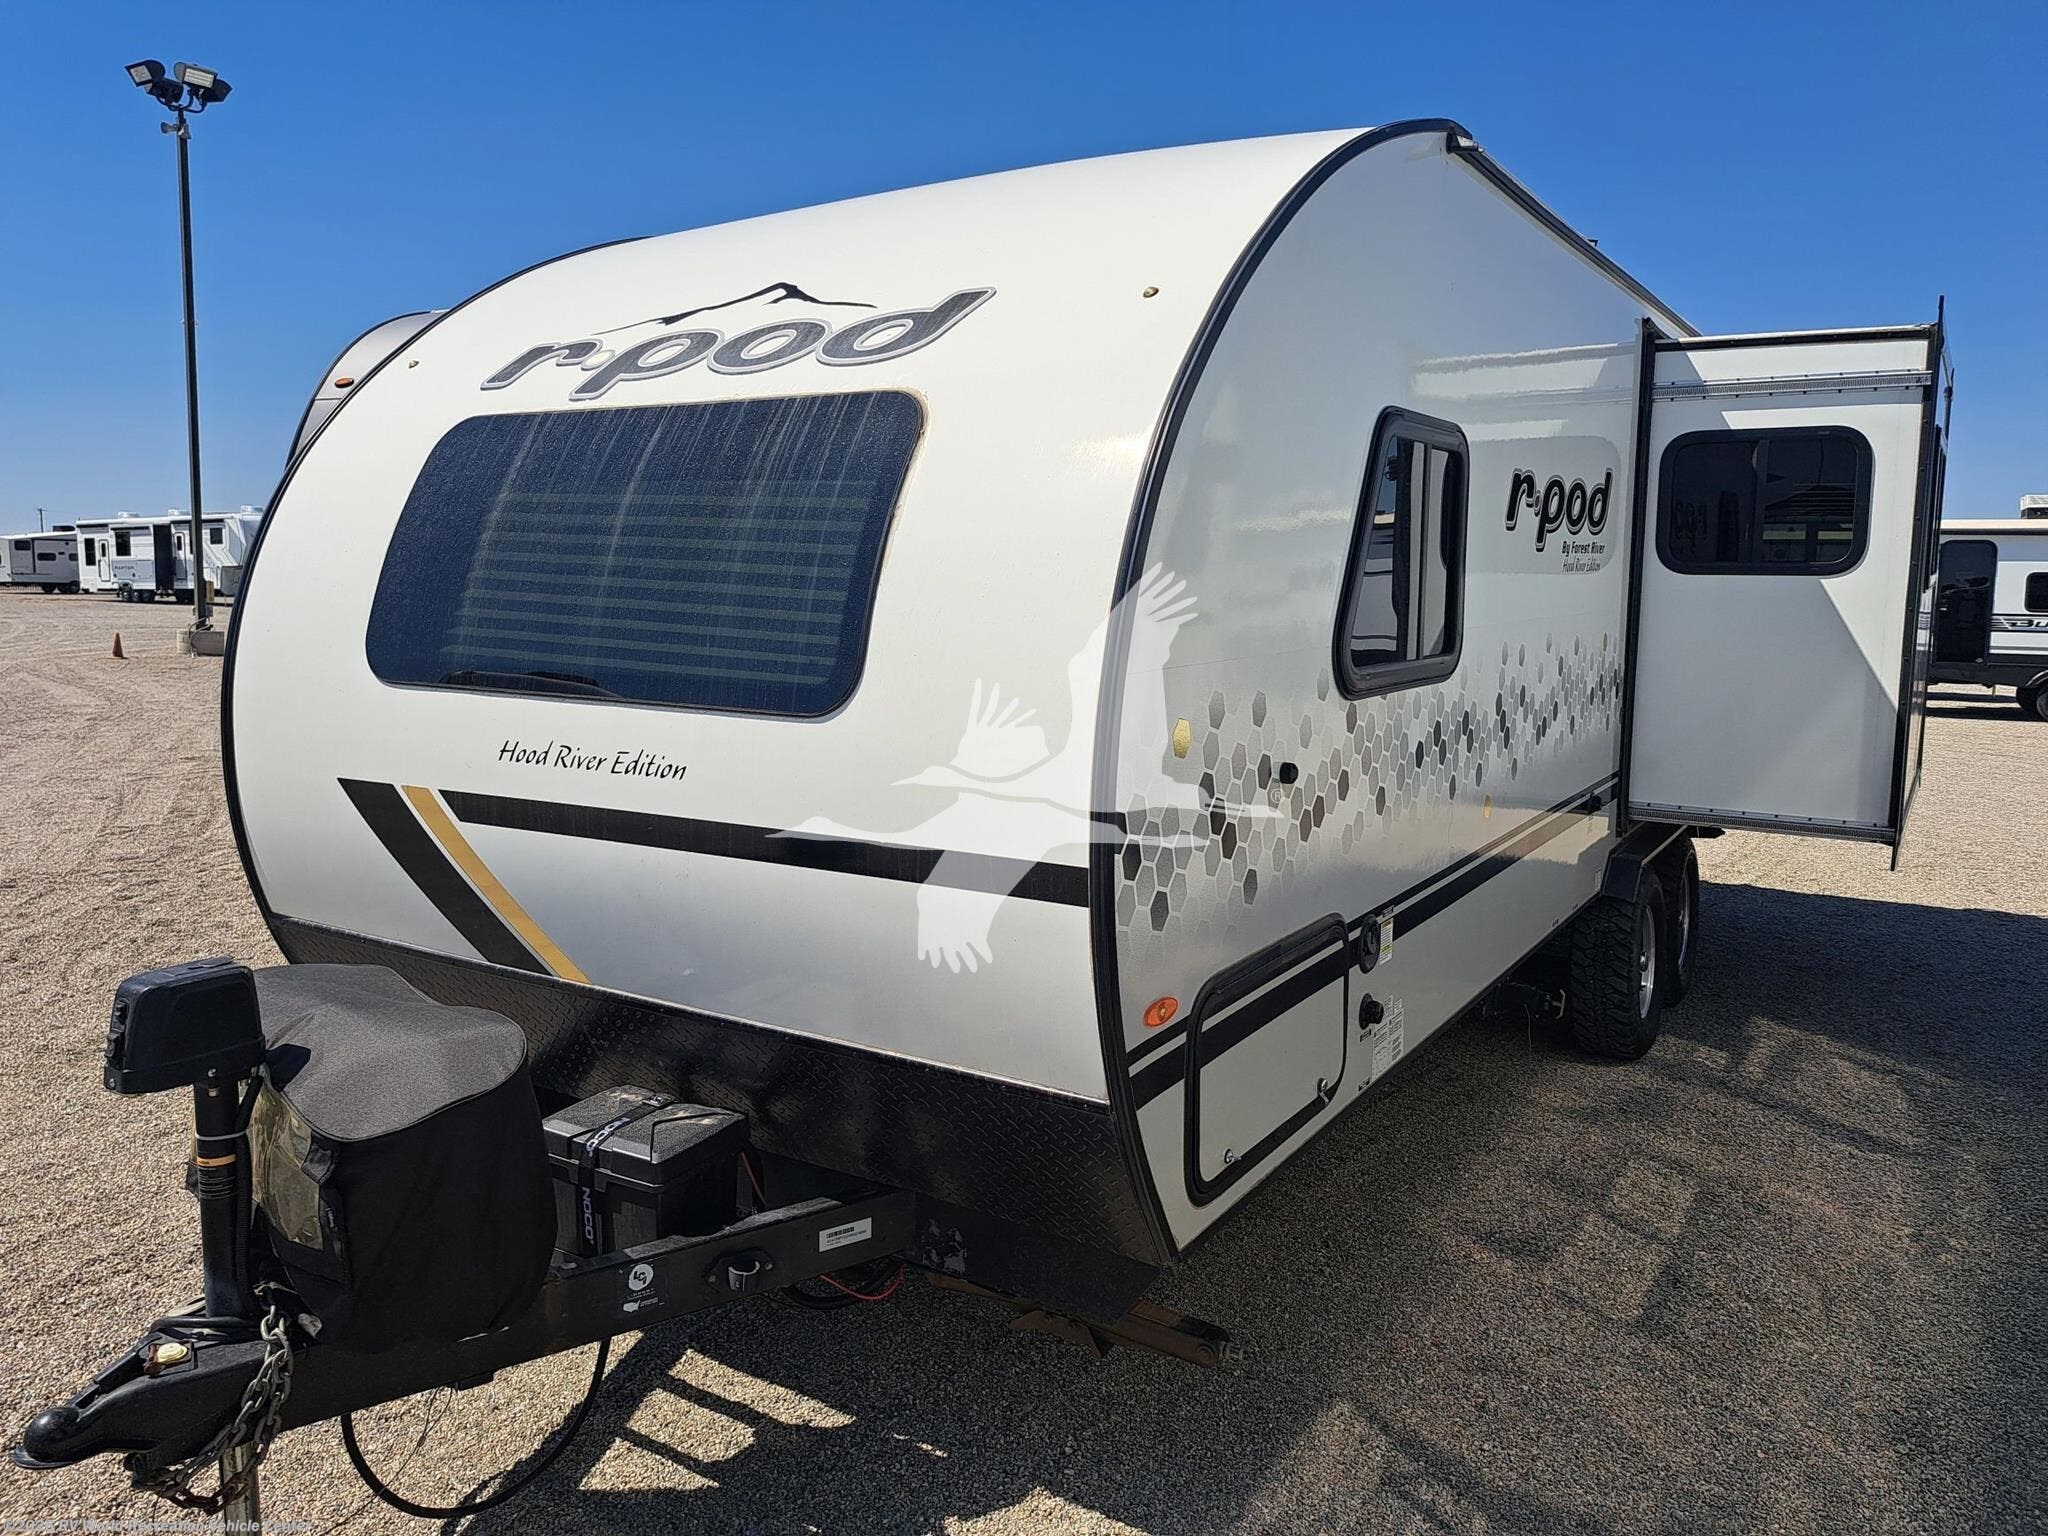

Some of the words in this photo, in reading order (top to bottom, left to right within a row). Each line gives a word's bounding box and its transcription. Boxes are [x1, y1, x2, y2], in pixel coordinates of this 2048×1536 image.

[1562, 540, 1570, 557] By
[1571, 541, 1590, 554] Forest
[1591, 541, 1605, 554] River
[498, 739, 553, 766] Hood
[553, 744, 607, 771] River
[610, 748, 687, 780] Edition
[586, 1117, 631, 1151] NOCO
[582, 1186, 594, 1241] NOCO
